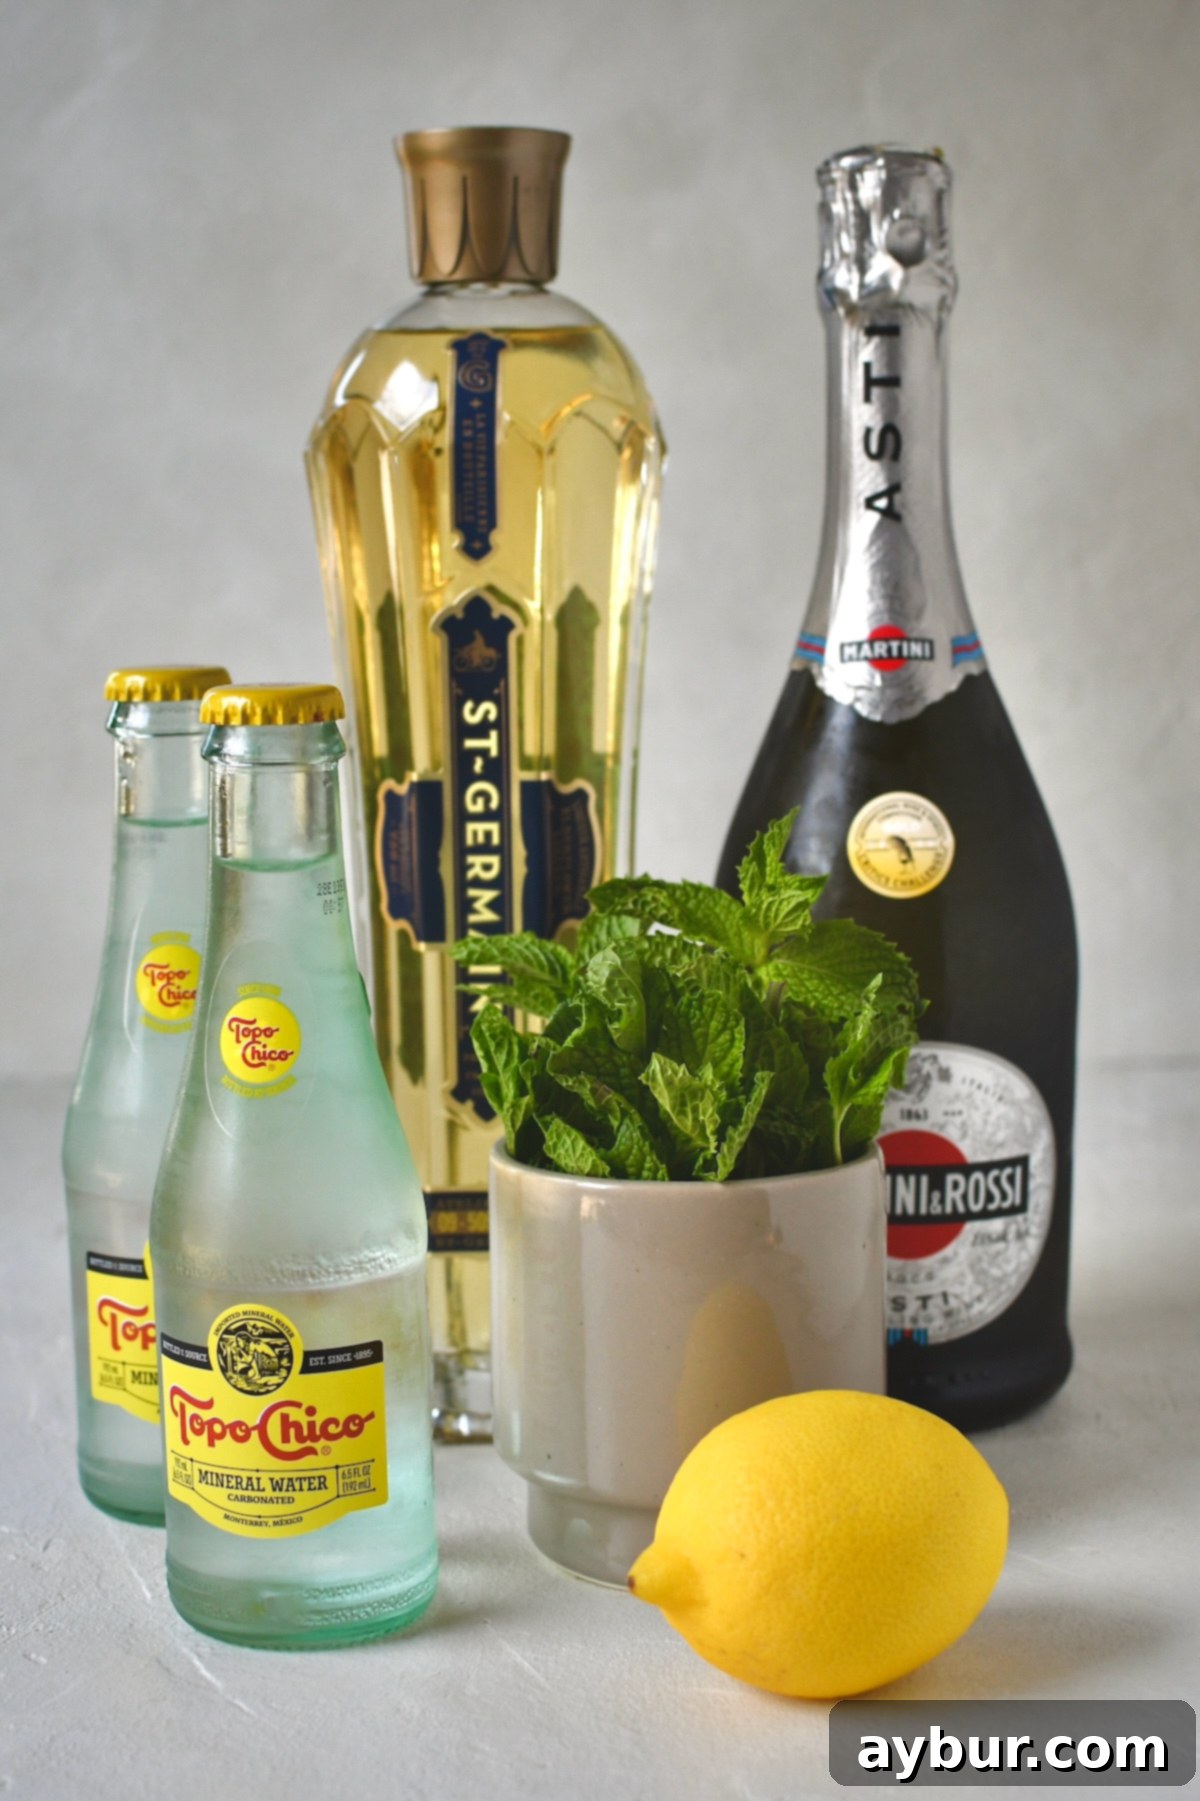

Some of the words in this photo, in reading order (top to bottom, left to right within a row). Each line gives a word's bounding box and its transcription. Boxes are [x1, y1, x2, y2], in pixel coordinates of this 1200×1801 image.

[863, 325, 902, 522] ASTI
[843, 641, 931, 662] MARTINI
[143, 963, 190, 986] Topo
[228, 1016, 279, 1044] Topo
[241, 1040, 294, 1069] Chico
[241, 1309, 274, 1321] MINERAL
[274, 1316, 295, 1339] WATER
[308, 1356, 326, 1366] EST.
[327, 1352, 352, 1365] SINCE
[168, 1385, 252, 1448] Topo
[255, 1399, 376, 1462] Chico
[198, 1468, 266, 1492] MINERAL
[269, 1474, 328, 1493] WATER
[227, 1492, 295, 1505] CARBONATED
